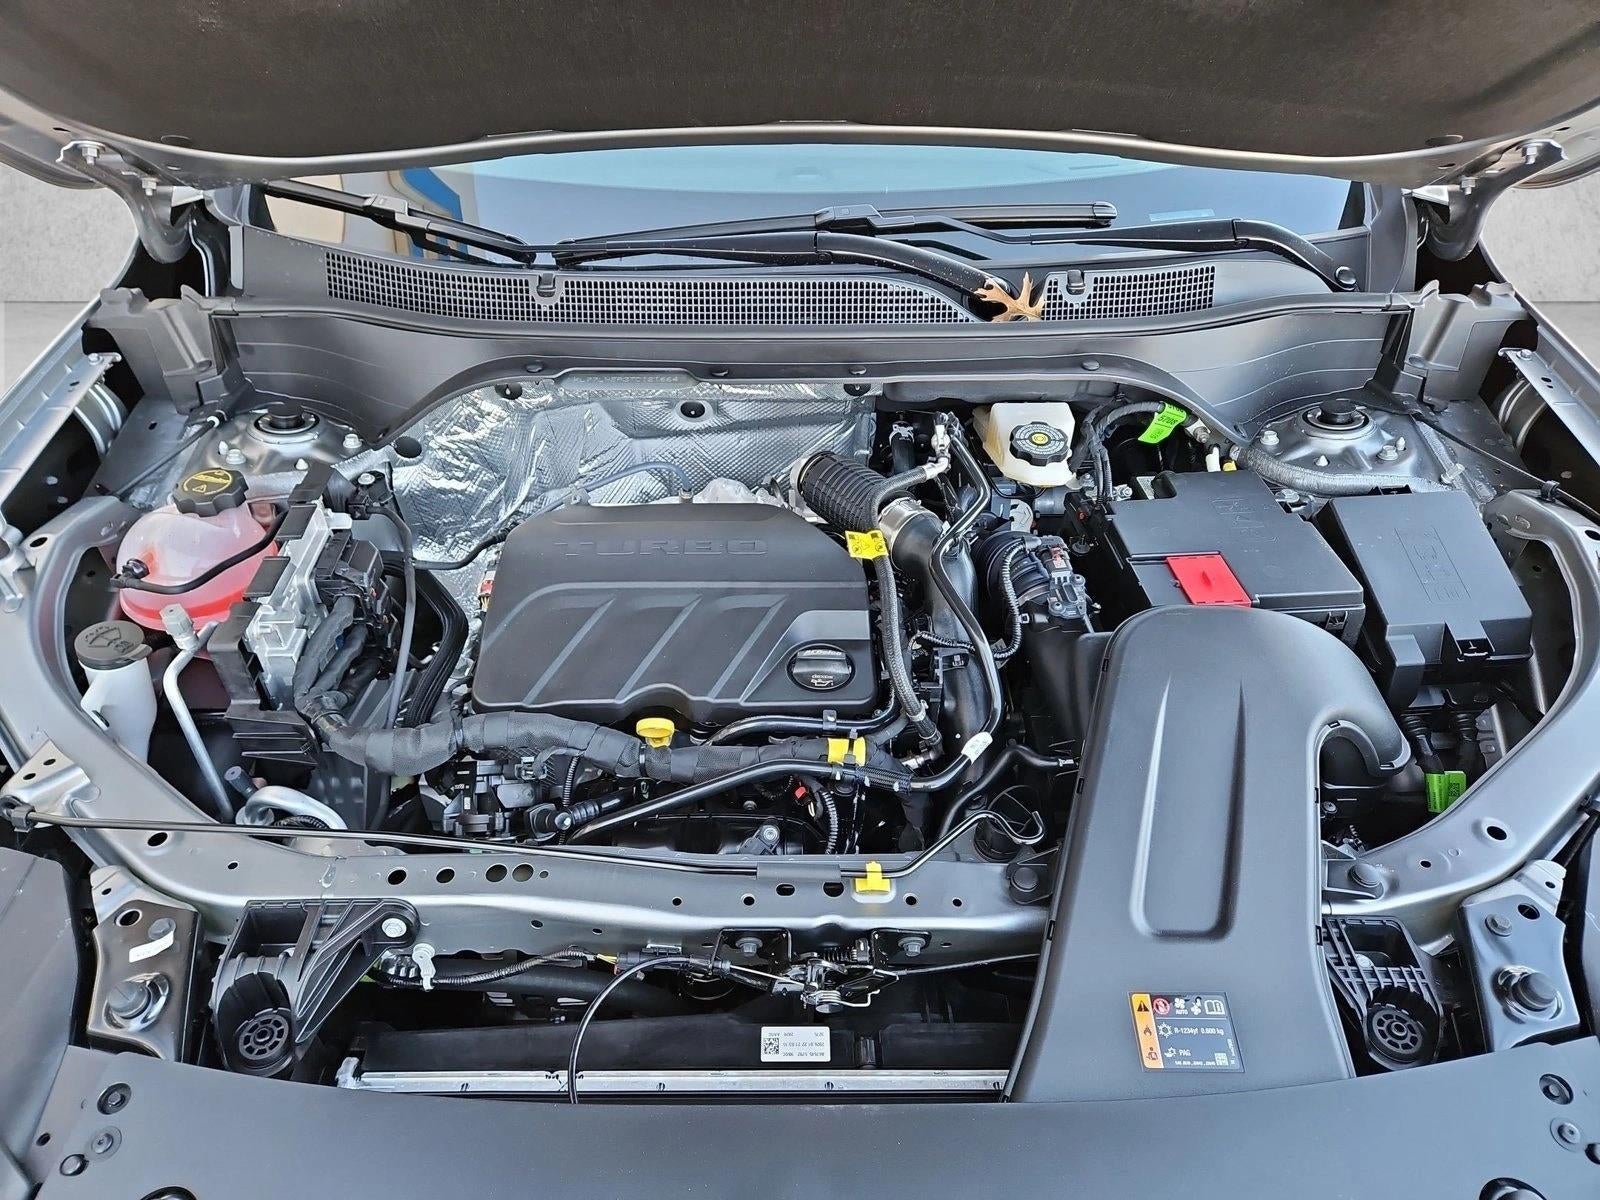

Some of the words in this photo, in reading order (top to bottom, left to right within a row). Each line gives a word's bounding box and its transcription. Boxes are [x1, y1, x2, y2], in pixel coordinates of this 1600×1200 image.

[553, 540, 769, 556] TURBO
[1174, 1027, 1199, 1035] R-1234yf
[1179, 1049, 1192, 1057] PAG
